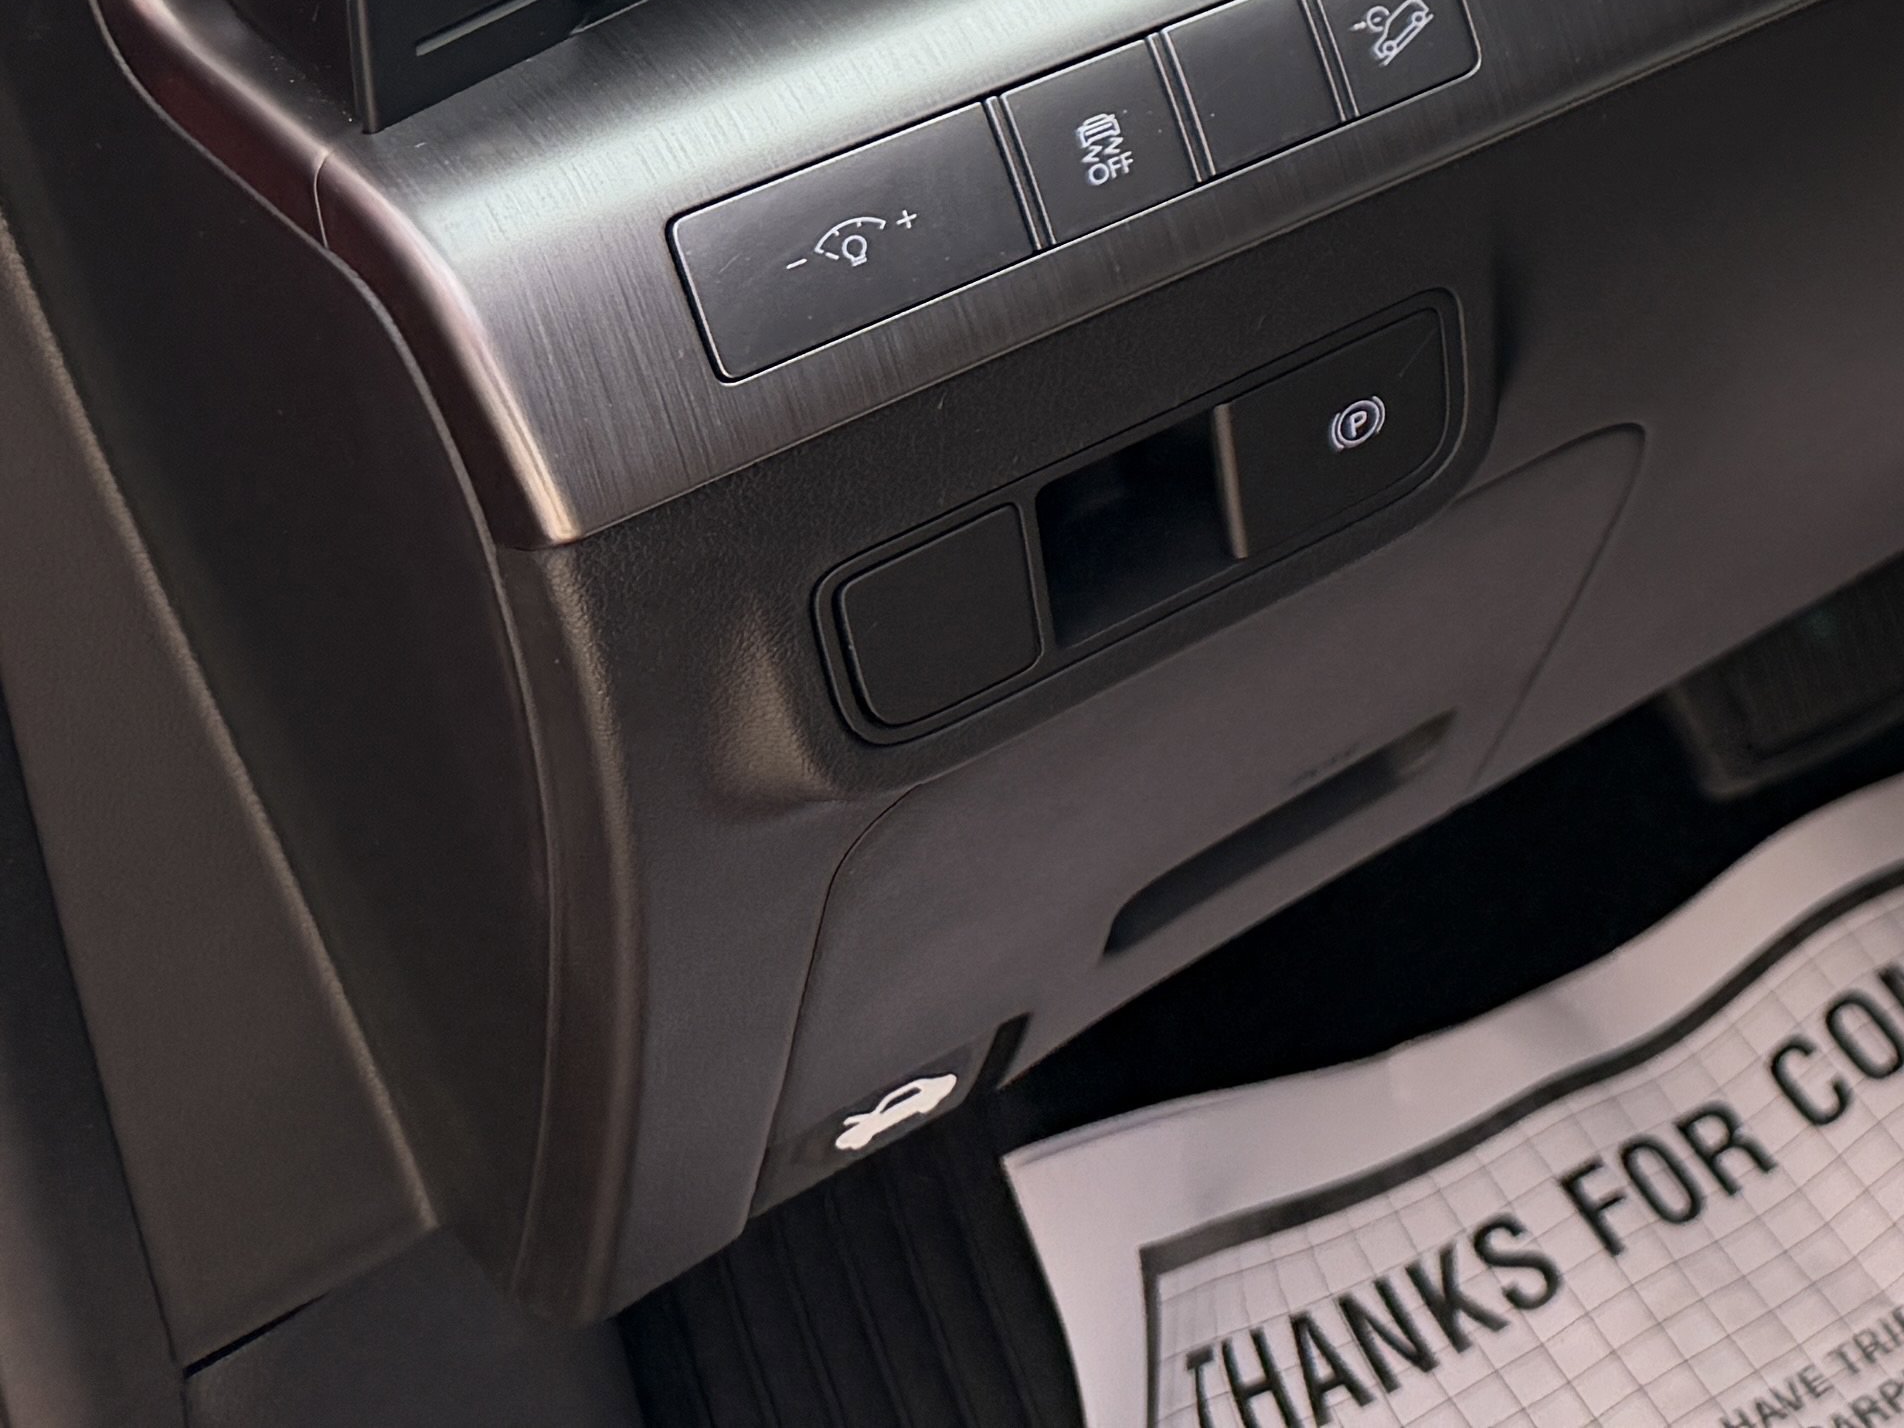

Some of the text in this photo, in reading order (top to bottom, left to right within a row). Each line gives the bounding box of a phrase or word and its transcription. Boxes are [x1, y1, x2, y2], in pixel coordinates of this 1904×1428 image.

[1088, 150, 1134, 186] OFF
[1186, 1211, 1564, 1428] THANKS
[1560, 1100, 1777, 1257] FOR
